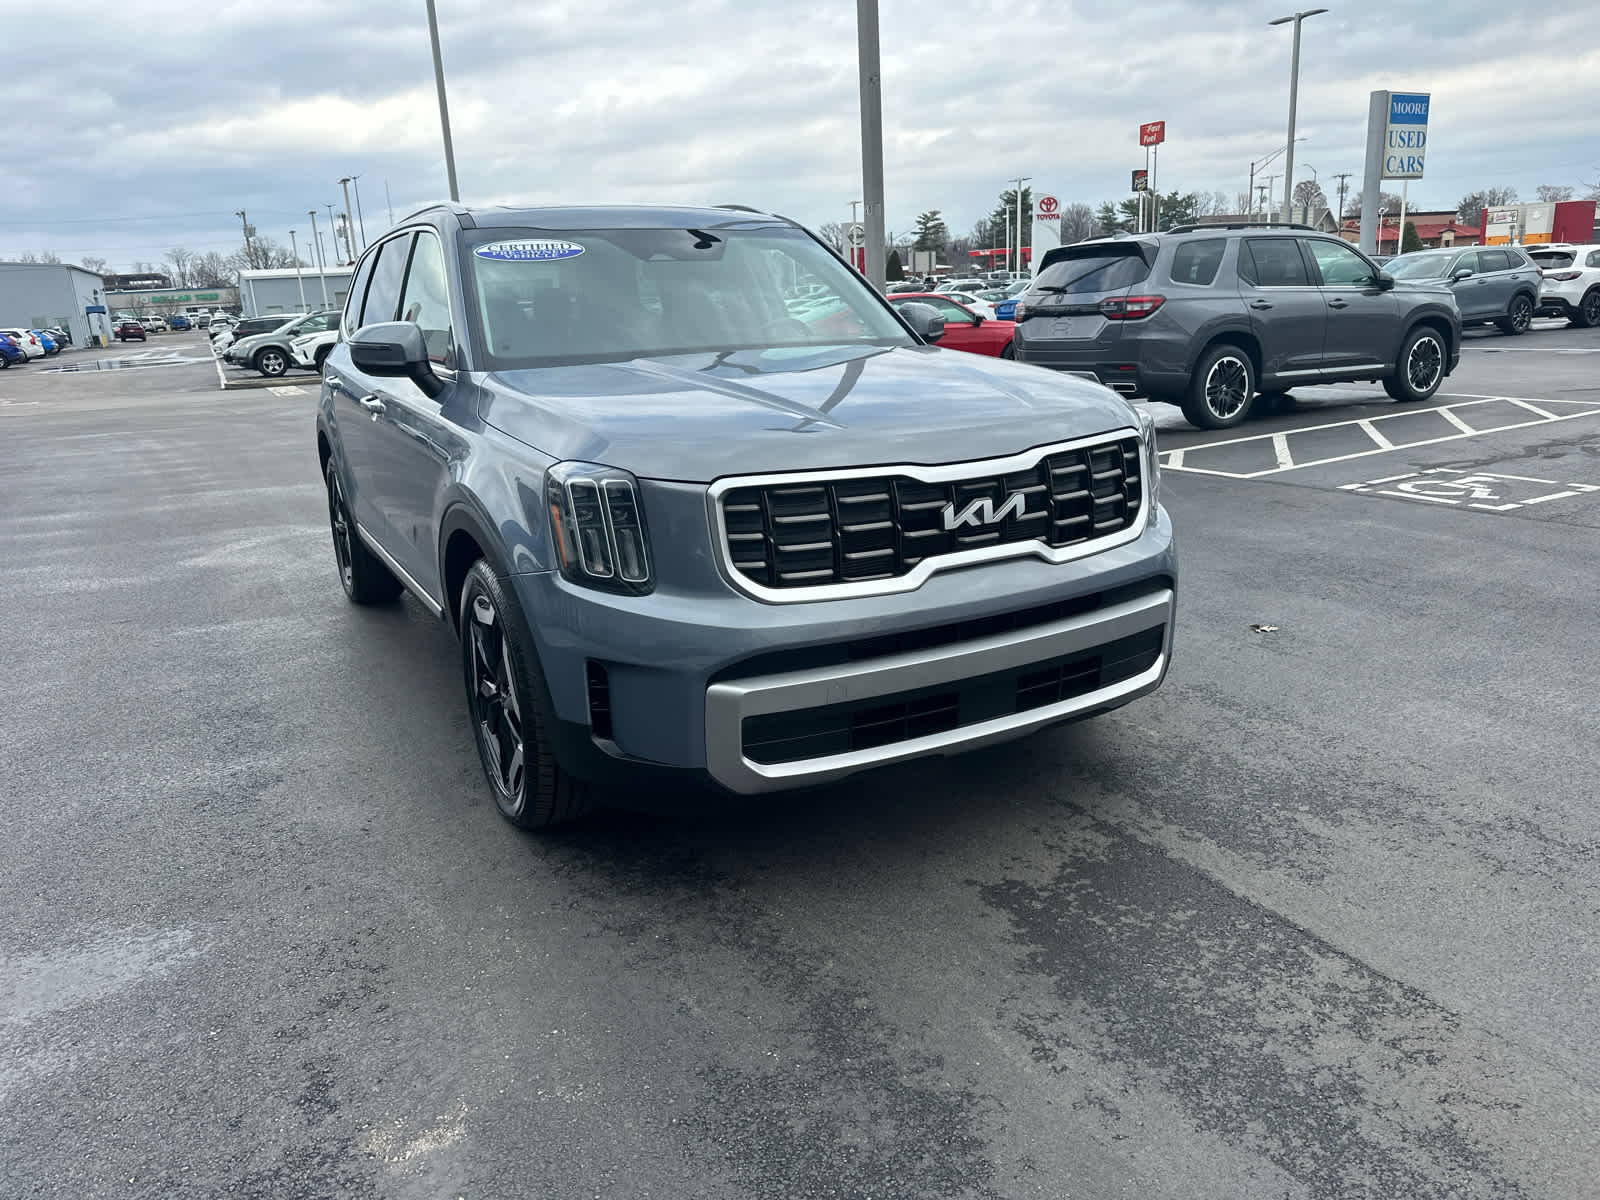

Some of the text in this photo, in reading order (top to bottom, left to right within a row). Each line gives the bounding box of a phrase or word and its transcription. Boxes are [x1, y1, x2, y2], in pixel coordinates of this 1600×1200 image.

[1392, 102, 1427, 114] MOORE
[1388, 130, 1427, 149] USED
[1386, 155, 1424, 173] CARS
[1036, 213, 1061, 221] TOYOTA
[487, 243, 572, 251] CERTIFIED
[941, 493, 1025, 530] KIA
